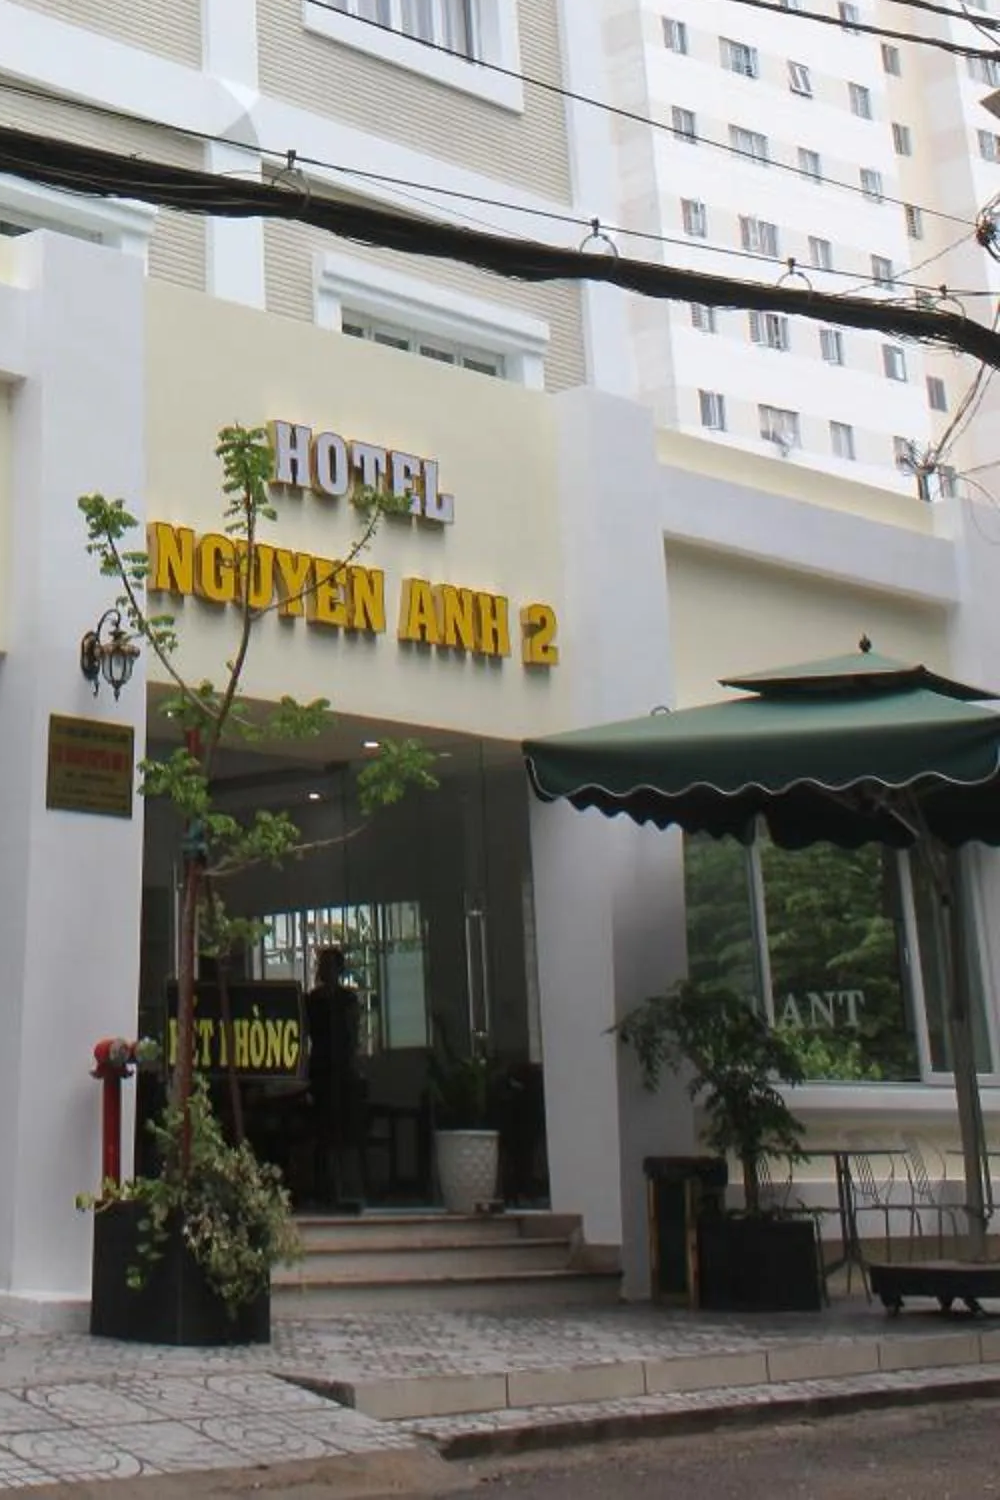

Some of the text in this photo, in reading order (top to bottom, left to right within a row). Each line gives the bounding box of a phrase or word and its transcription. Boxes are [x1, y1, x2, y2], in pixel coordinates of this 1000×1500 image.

[270, 419, 455, 525] HOTEL
[146, 521, 559, 666] NGUYEN ANH 2
